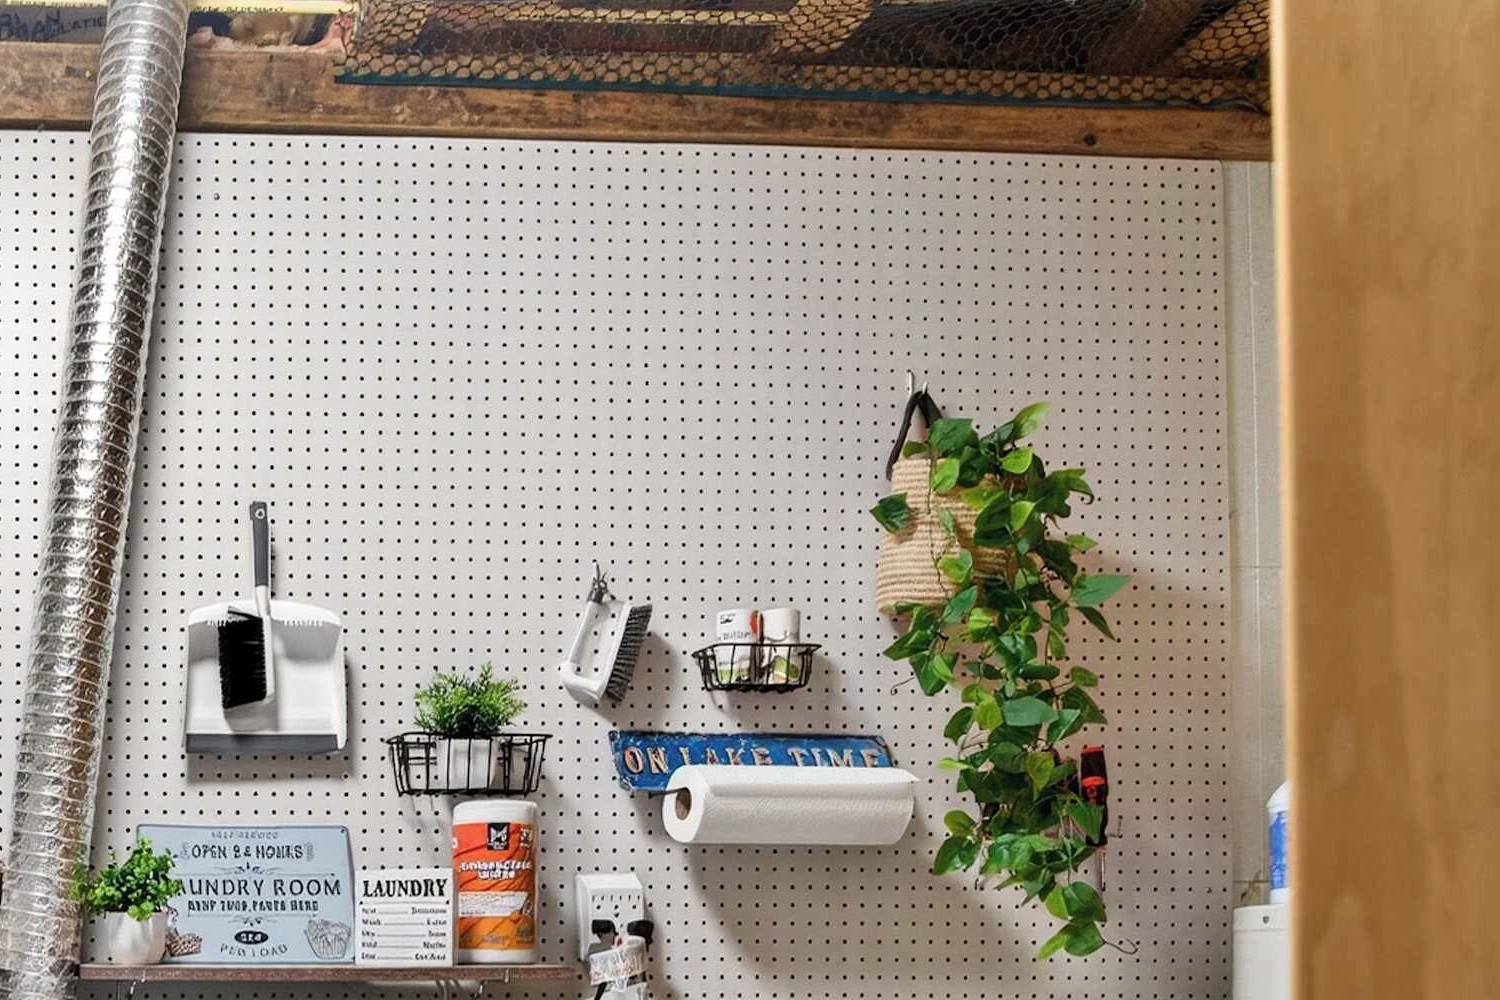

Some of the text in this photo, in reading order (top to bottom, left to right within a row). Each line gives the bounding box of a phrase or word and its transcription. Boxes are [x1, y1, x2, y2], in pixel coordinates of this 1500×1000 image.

[625, 746, 669, 774] ON
[191, 844, 227, 859] OPEN
[273, 878, 341, 897] ROOM
[363, 879, 448, 897] LAUNDRY
